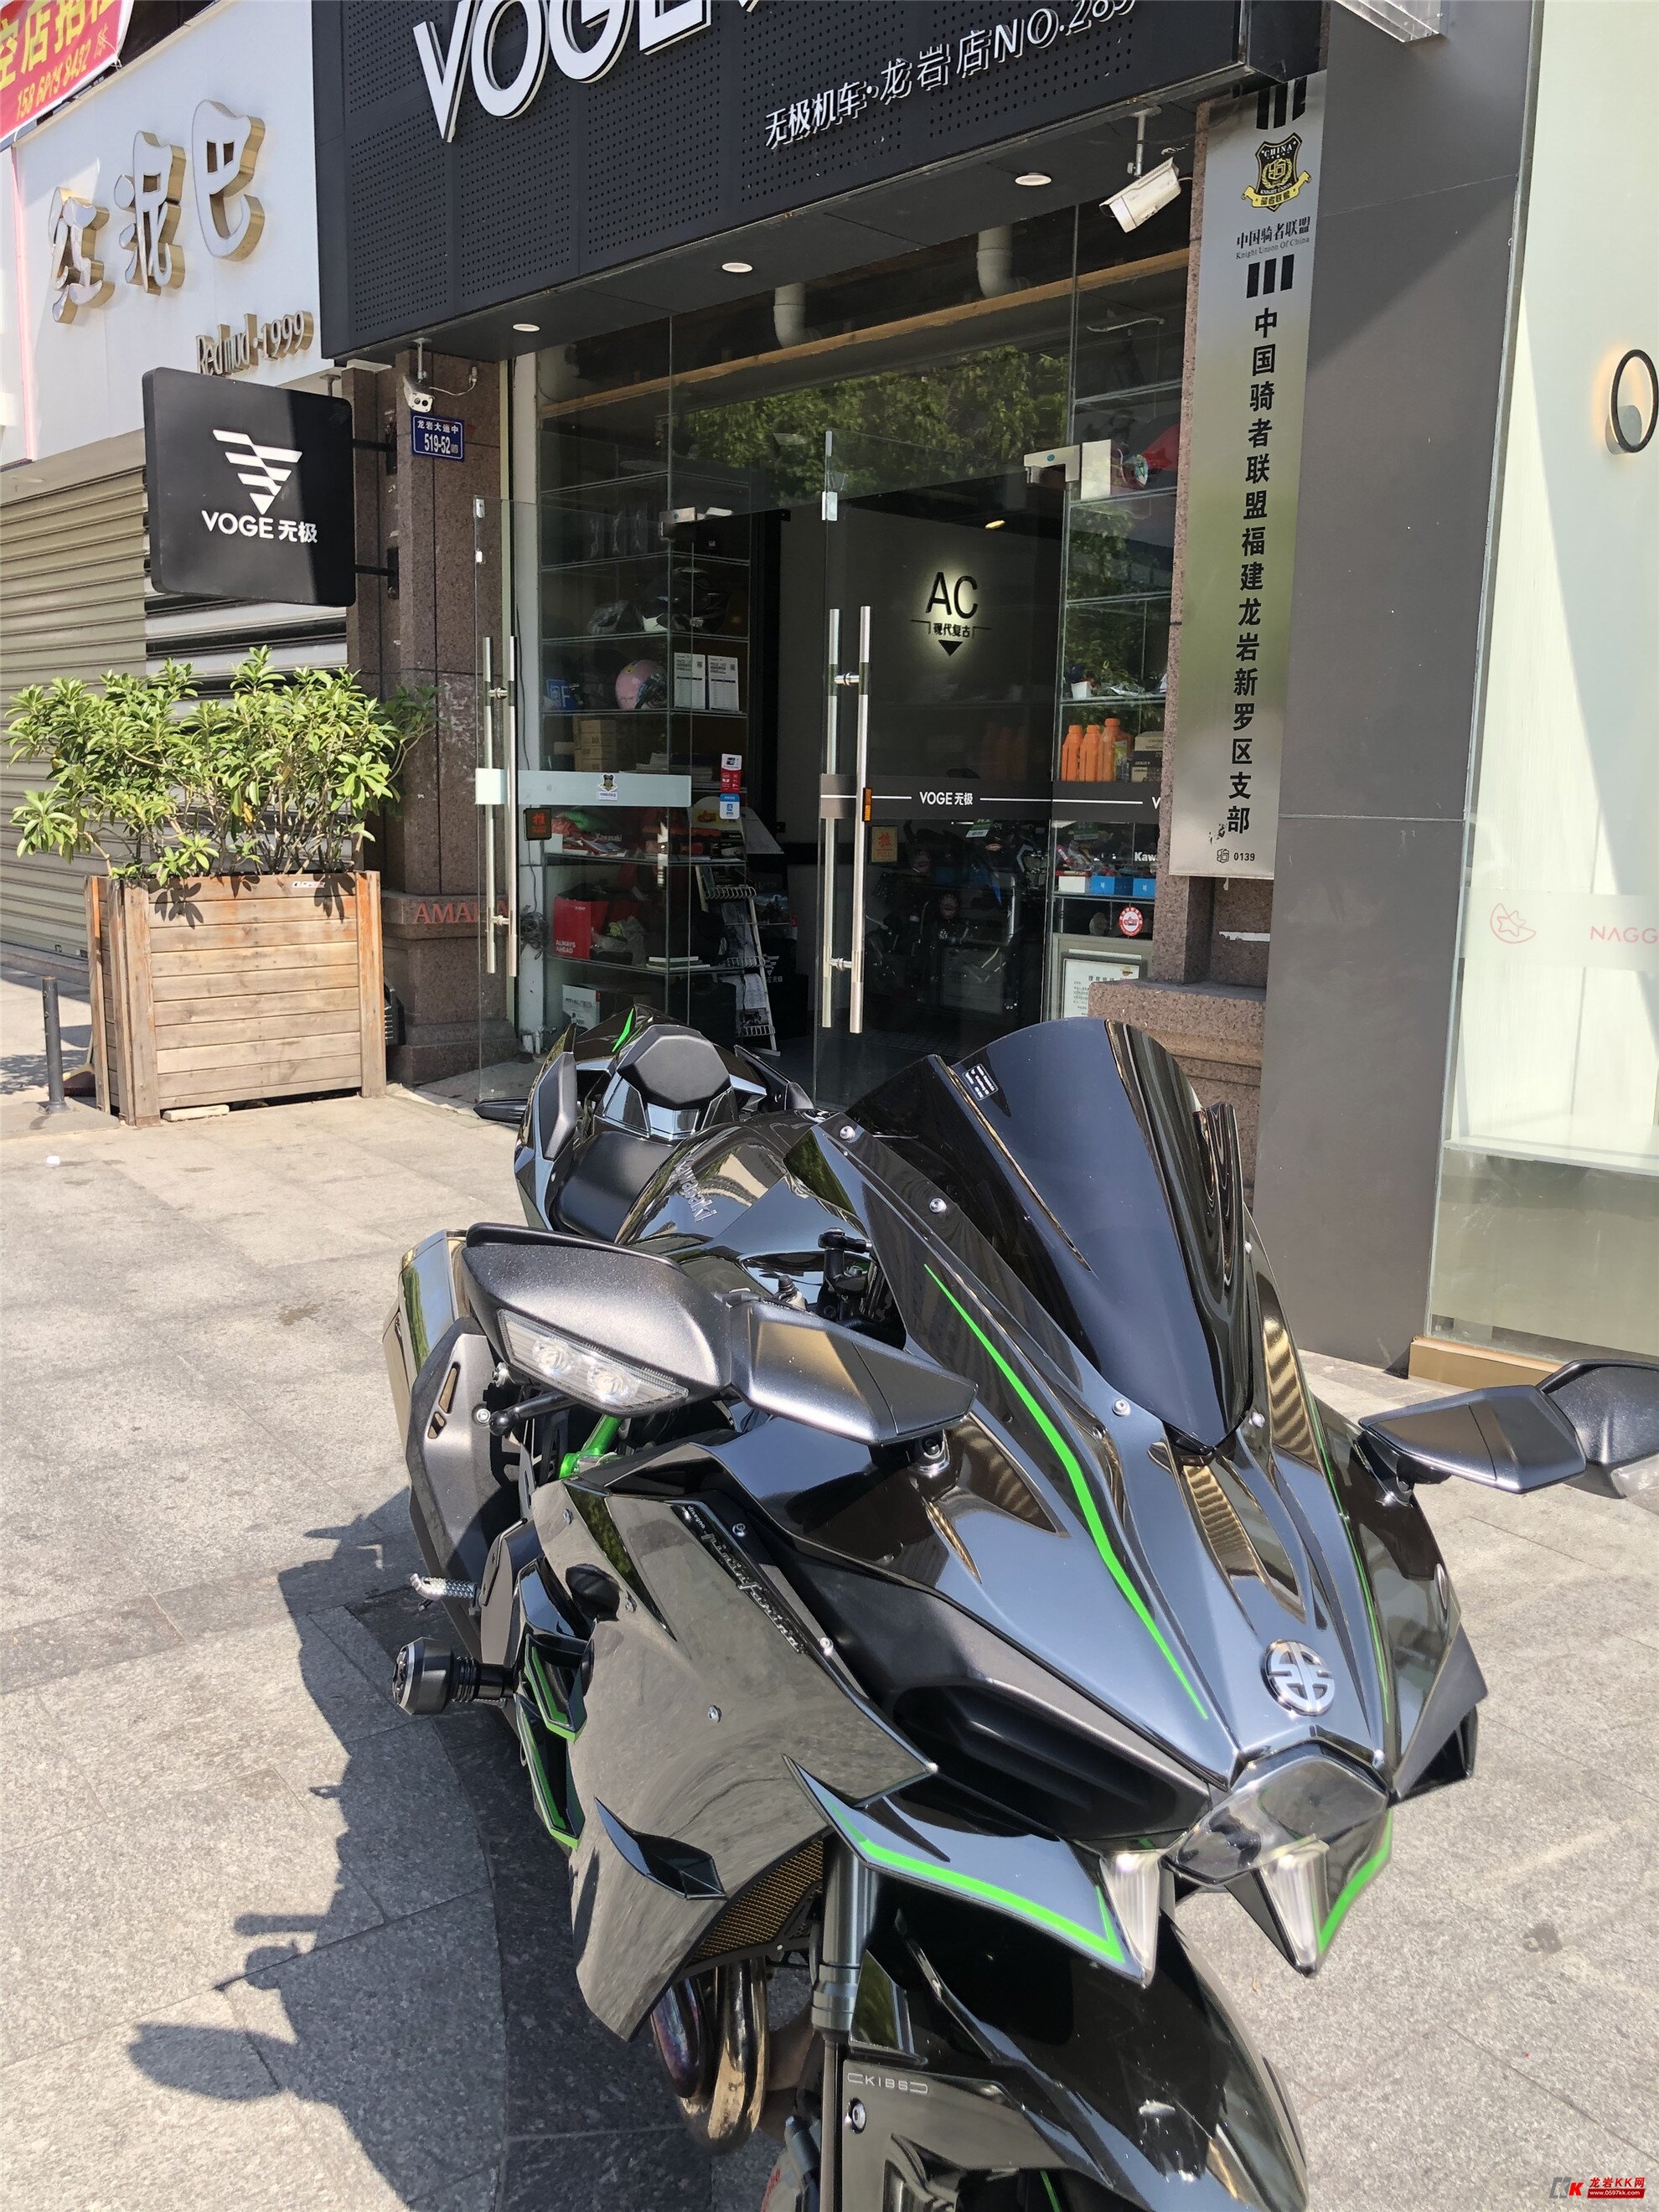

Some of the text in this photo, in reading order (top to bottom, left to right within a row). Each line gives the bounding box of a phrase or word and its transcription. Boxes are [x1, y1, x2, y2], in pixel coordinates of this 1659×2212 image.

[1264, 143, 1293, 158] CHINA
[1237, 216, 1310, 249] 中国骑者联盟
[1236, 236, 1310, 260] Knight Union Of China
[417, 420, 459, 434] 龙岩大道中
[201, 509, 318, 543] VOGE 无极
[1227, 307, 1278, 835] 中国骑者联盟福建龙岩新罗区支部
[925, 571, 978, 619] AC
[933, 623, 971, 638] 现代复古
[919, 791, 973, 805] VOGE 无极
[1134, 851, 1158, 862] Kaw
[1233, 852, 1255, 861] 0139
[556, 939, 576, 948] ALWAYS
[687, 1505, 705, 1529] disegno
